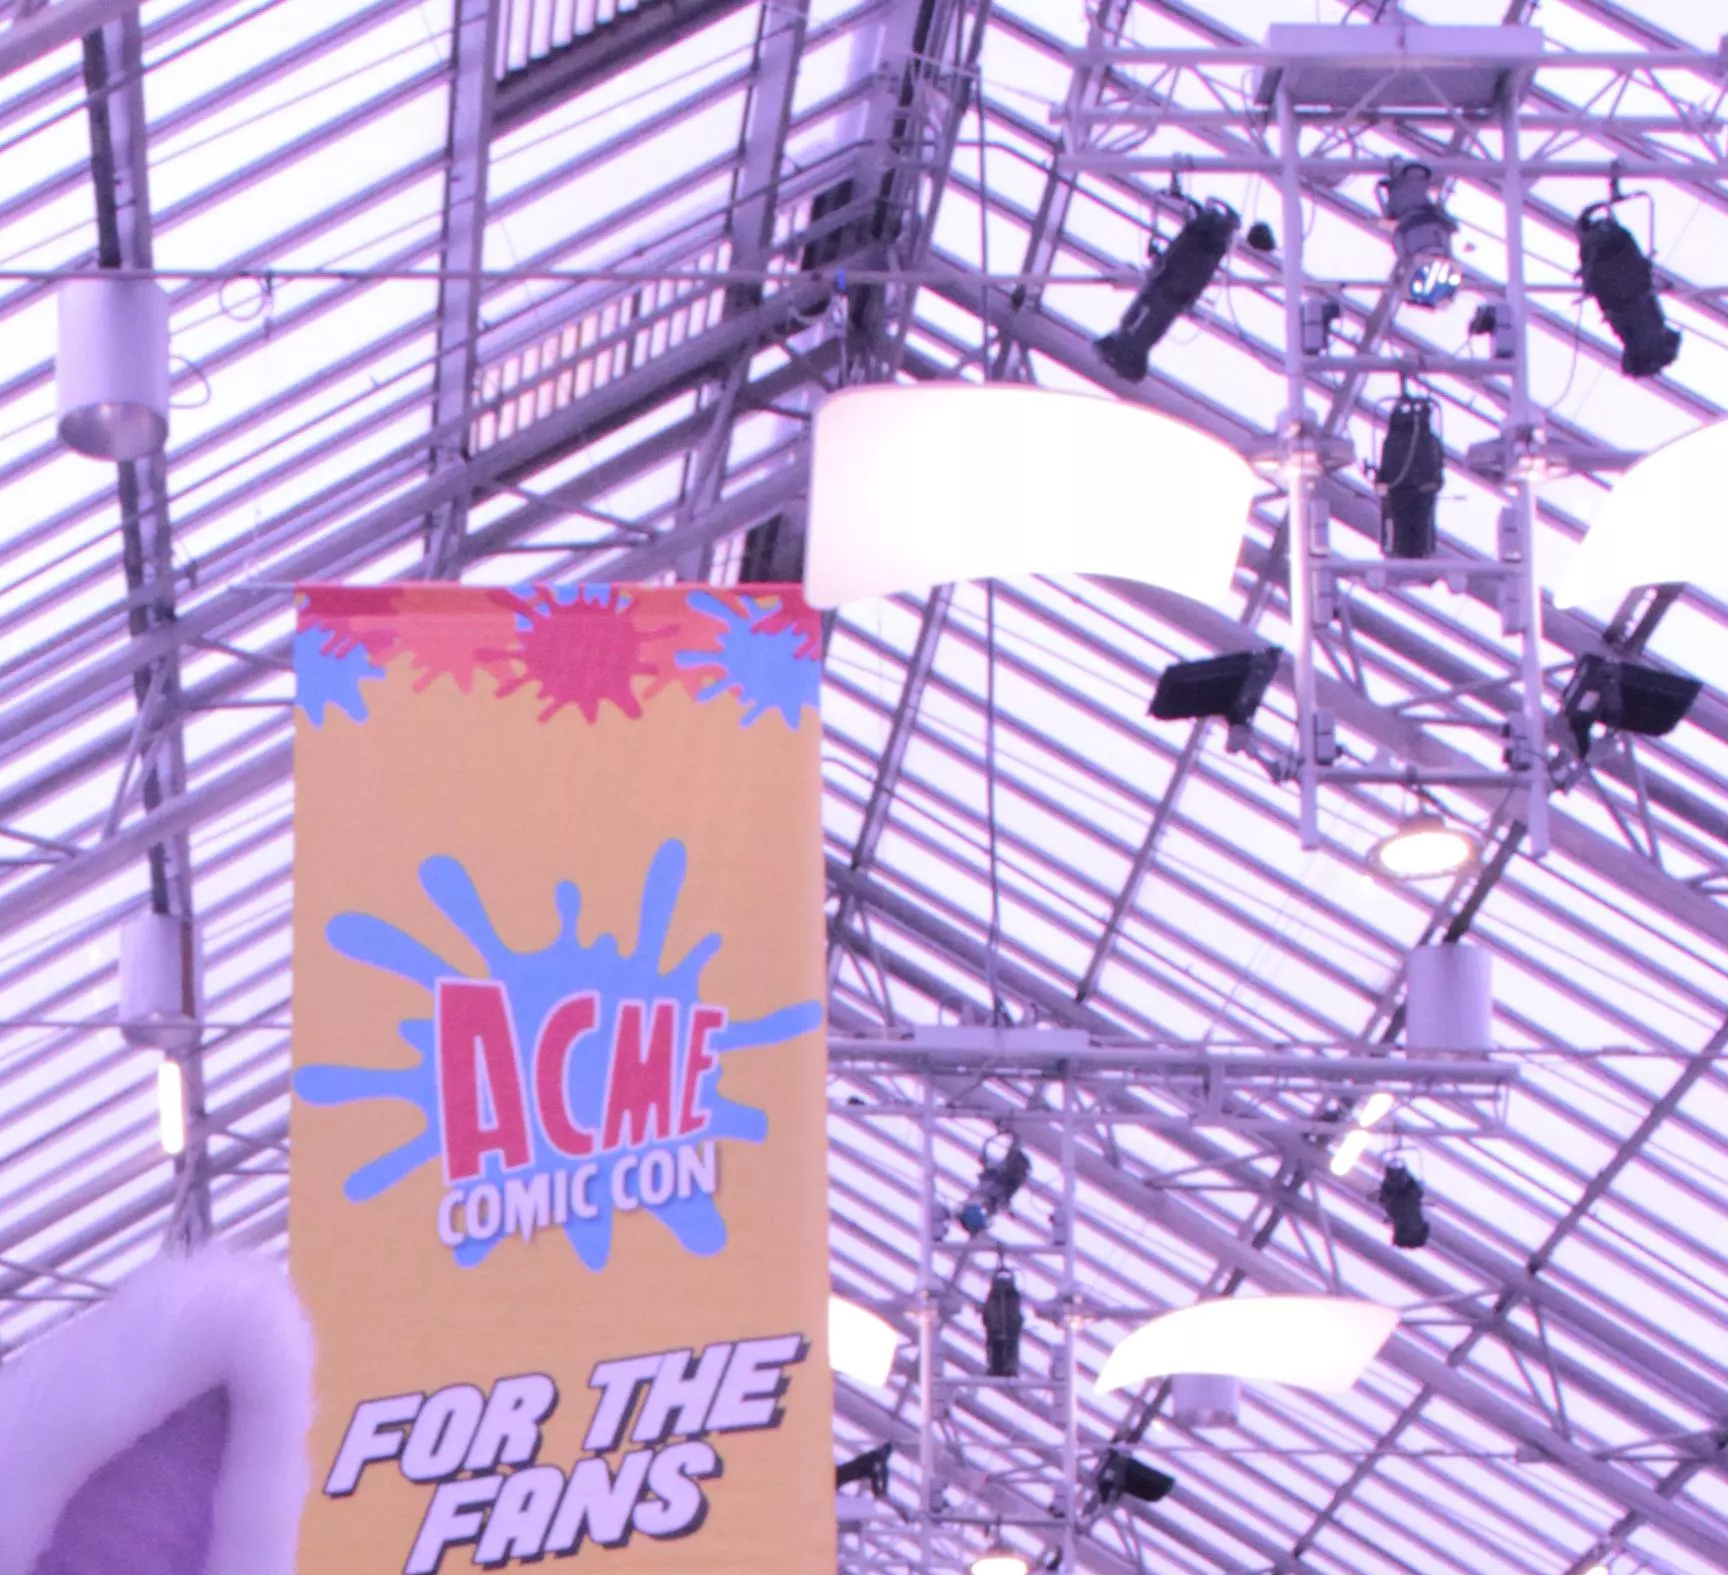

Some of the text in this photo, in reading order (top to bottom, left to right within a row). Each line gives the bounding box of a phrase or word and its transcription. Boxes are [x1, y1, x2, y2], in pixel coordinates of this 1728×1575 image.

[435, 977, 728, 1185] ACME
[438, 1141, 718, 1247] COMIC CON
[324, 1333, 810, 1498] FOR THE
